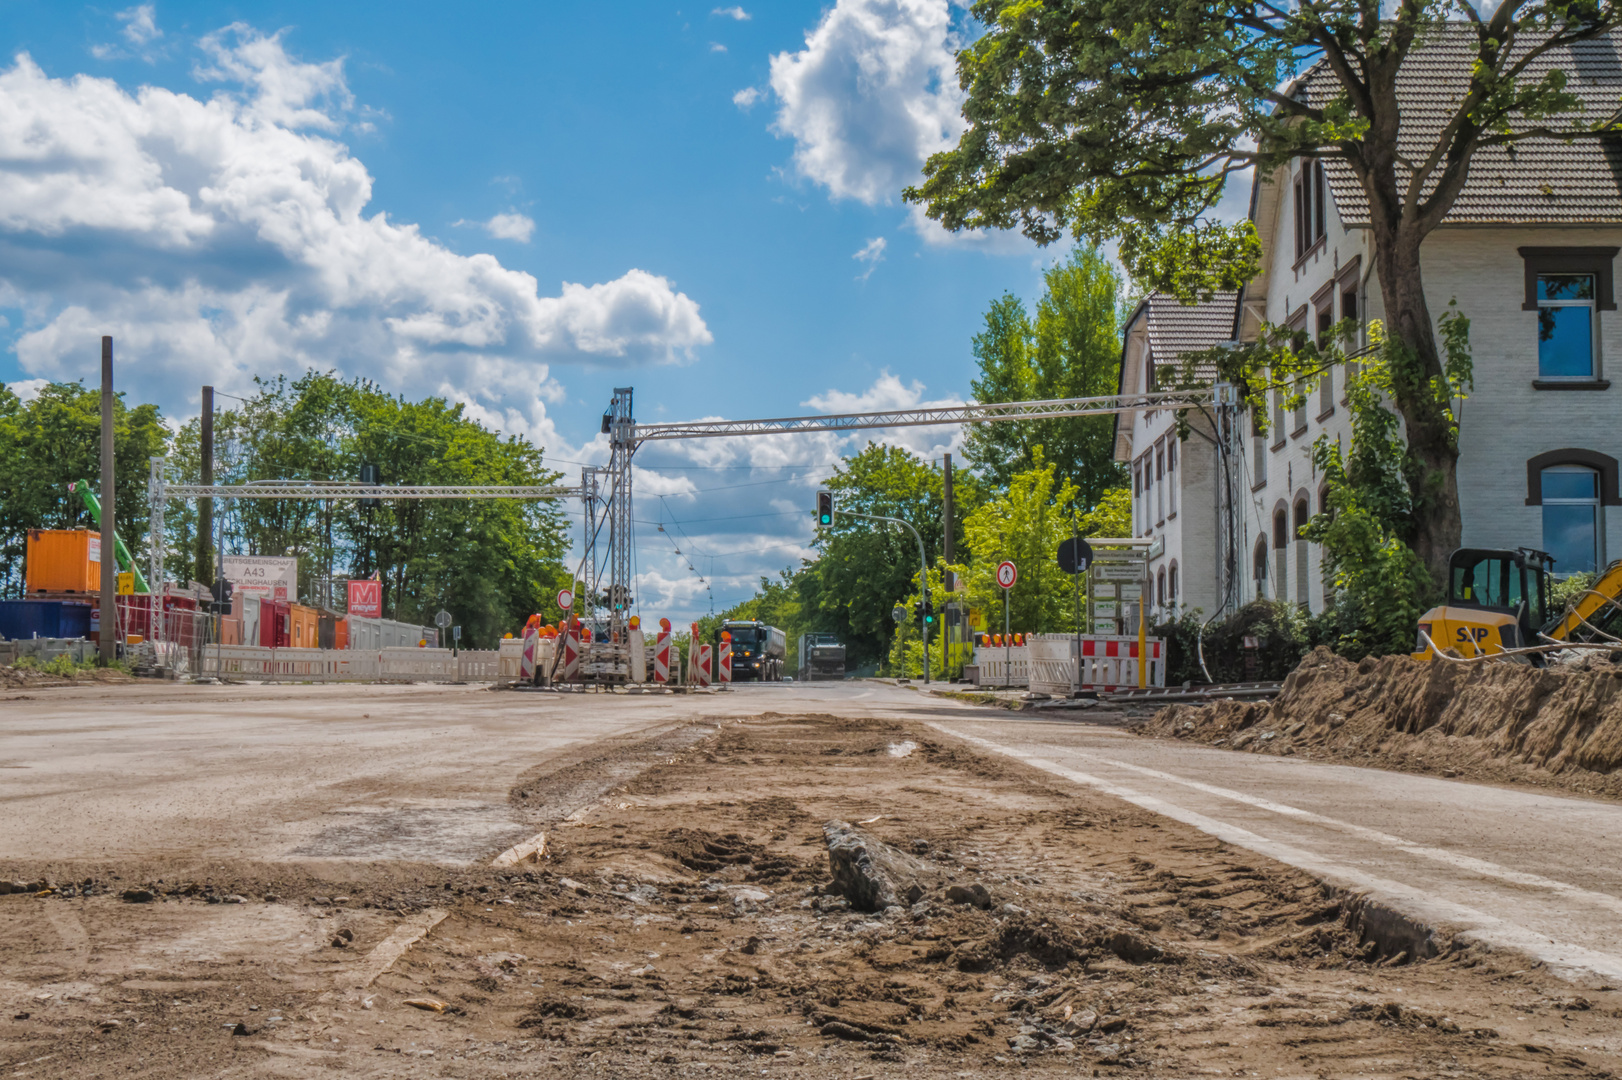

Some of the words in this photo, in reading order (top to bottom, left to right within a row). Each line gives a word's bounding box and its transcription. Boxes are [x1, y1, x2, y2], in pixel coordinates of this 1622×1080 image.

[243, 567, 265, 577] A43
[351, 583, 378, 604] M
[351, 604, 378, 612] meyer
